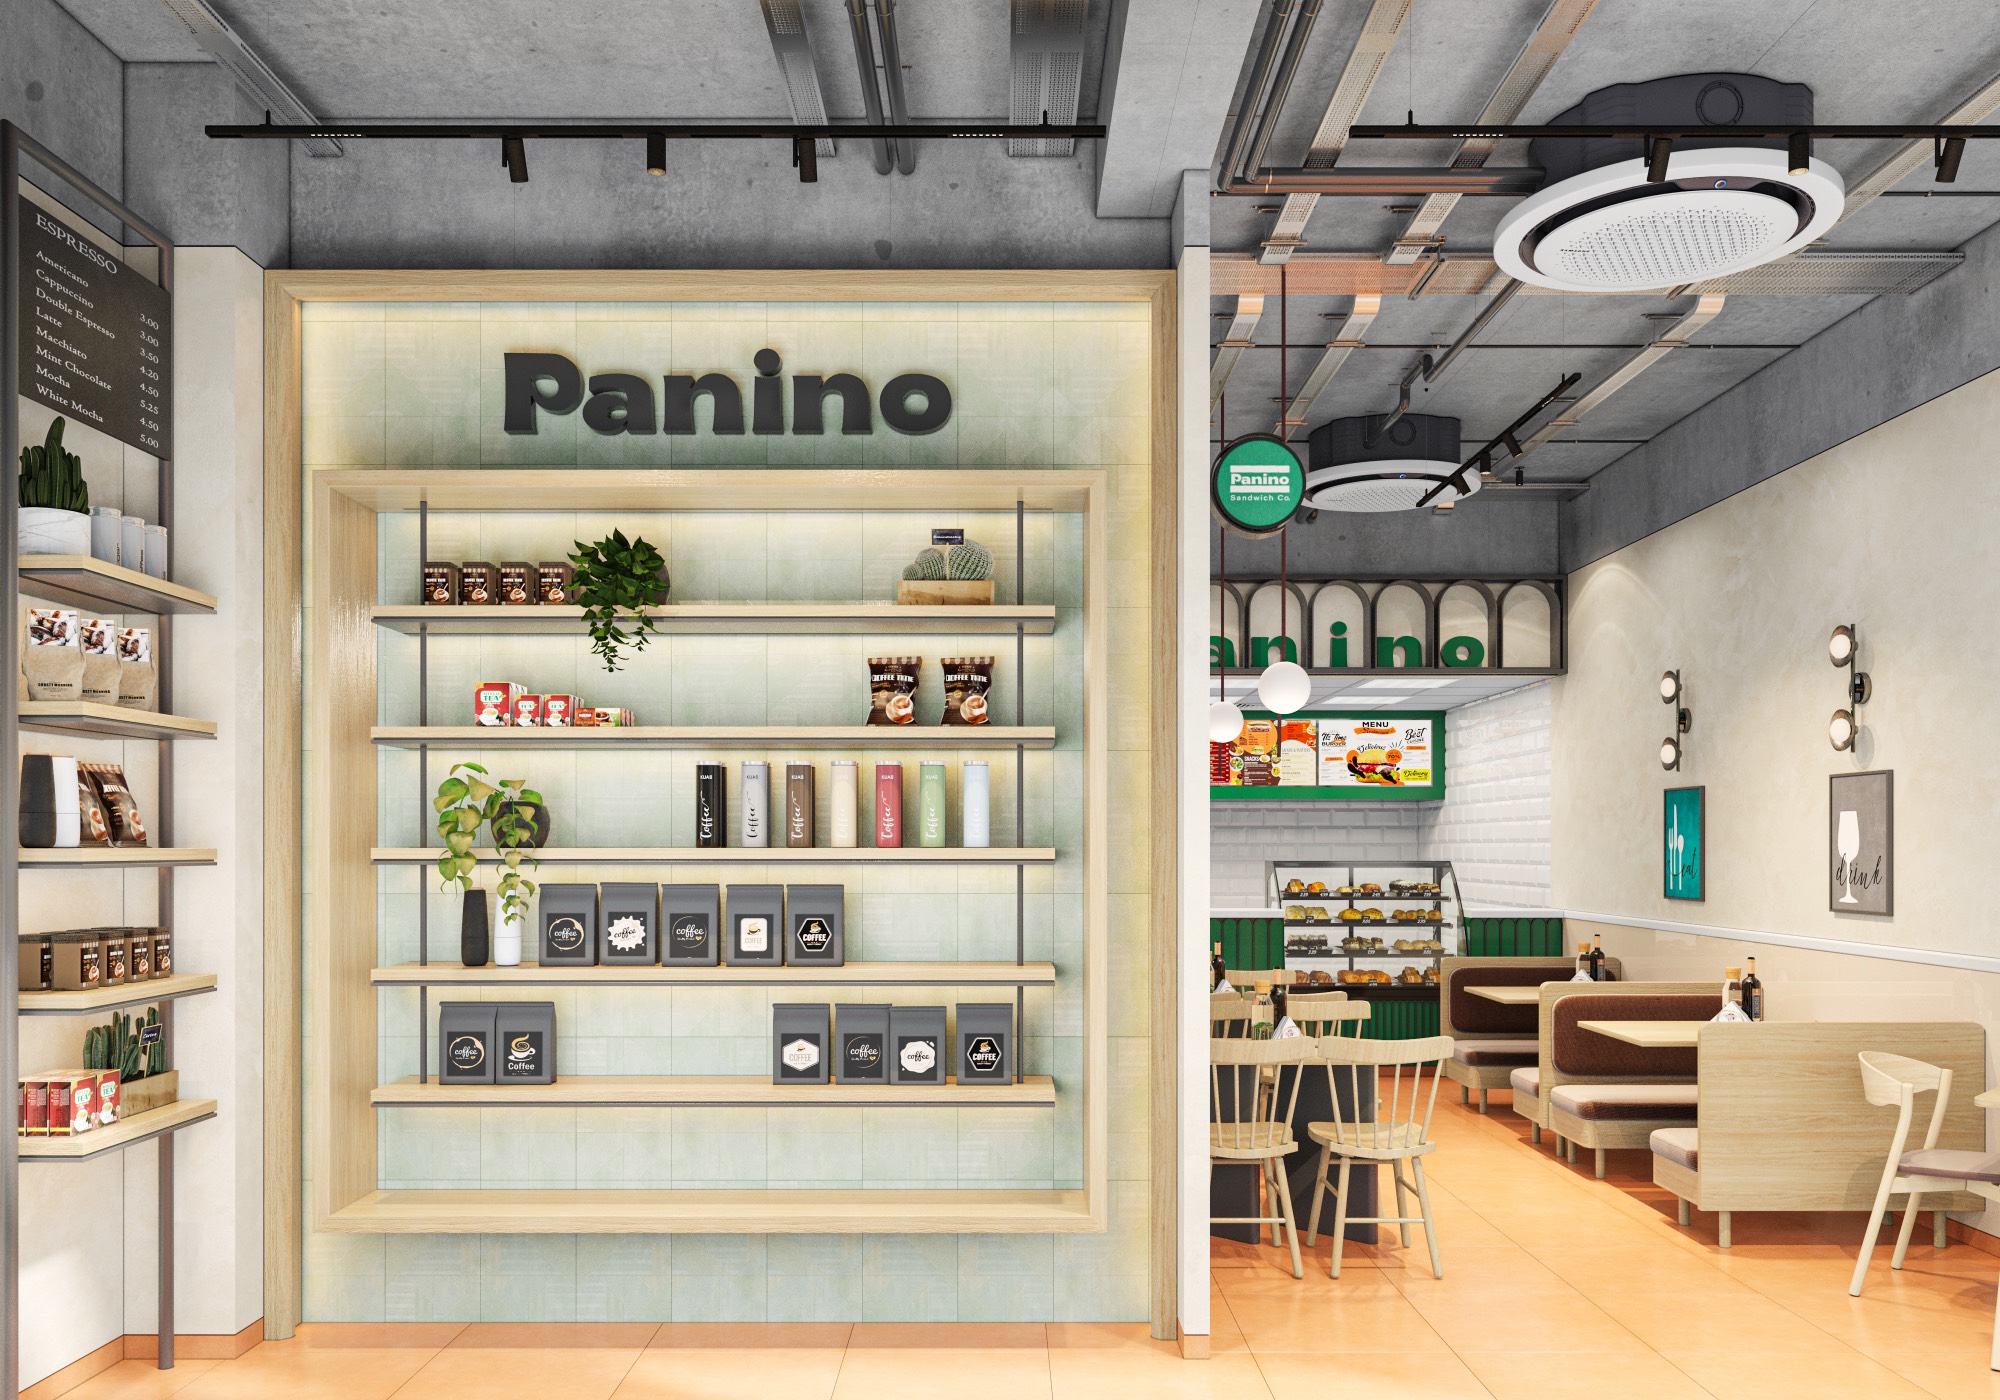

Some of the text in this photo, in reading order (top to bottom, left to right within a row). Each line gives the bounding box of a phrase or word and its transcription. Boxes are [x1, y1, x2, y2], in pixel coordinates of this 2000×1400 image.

[36, 213, 117, 275] ESPRESSO
[36, 250, 159, 331] Americano 3.00
[36, 268, 159, 347] Cappuccino 3.00
[36, 287, 159, 364] Double Espresso 3.50
[36, 306, 159, 381] Latte 4.20
[36, 325, 159, 398] Macchiato 4.50
[36, 344, 159, 415] Mint Chocolate 5.25
[36, 363, 159, 432] Mocha 4.50
[503, 348, 952, 435] Panino
[36, 383, 159, 449] White Mocha 5.00
[1230, 473, 1290, 485] Panino
[1210, 621, 1485, 667] anino
[699, 791, 713, 840] Coffee
[791, 791, 804, 840] Coffee
[881, 791, 894, 840] Coffee
[925, 791, 939, 840] Coffee
[1673, 847, 1698, 880] eat
[1836, 853, 1883, 890] drink
[554, 927, 577, 939] coffee
[614, 927, 636, 939] coffee
[676, 924, 704, 938] coffee
[803, 933, 827, 942] COFFEE
[454, 1046, 478, 1057] coffee
[508, 1062, 535, 1070] Coffee
[789, 1053, 812, 1062] COFFEE
[850, 1044, 878, 1058] coffee
[907, 1050, 930, 1062] coffee
[972, 1053, 997, 1061] COFFEE
[77, 1094, 89, 1102] TEA
[103, 1086, 114, 1095] TEA
